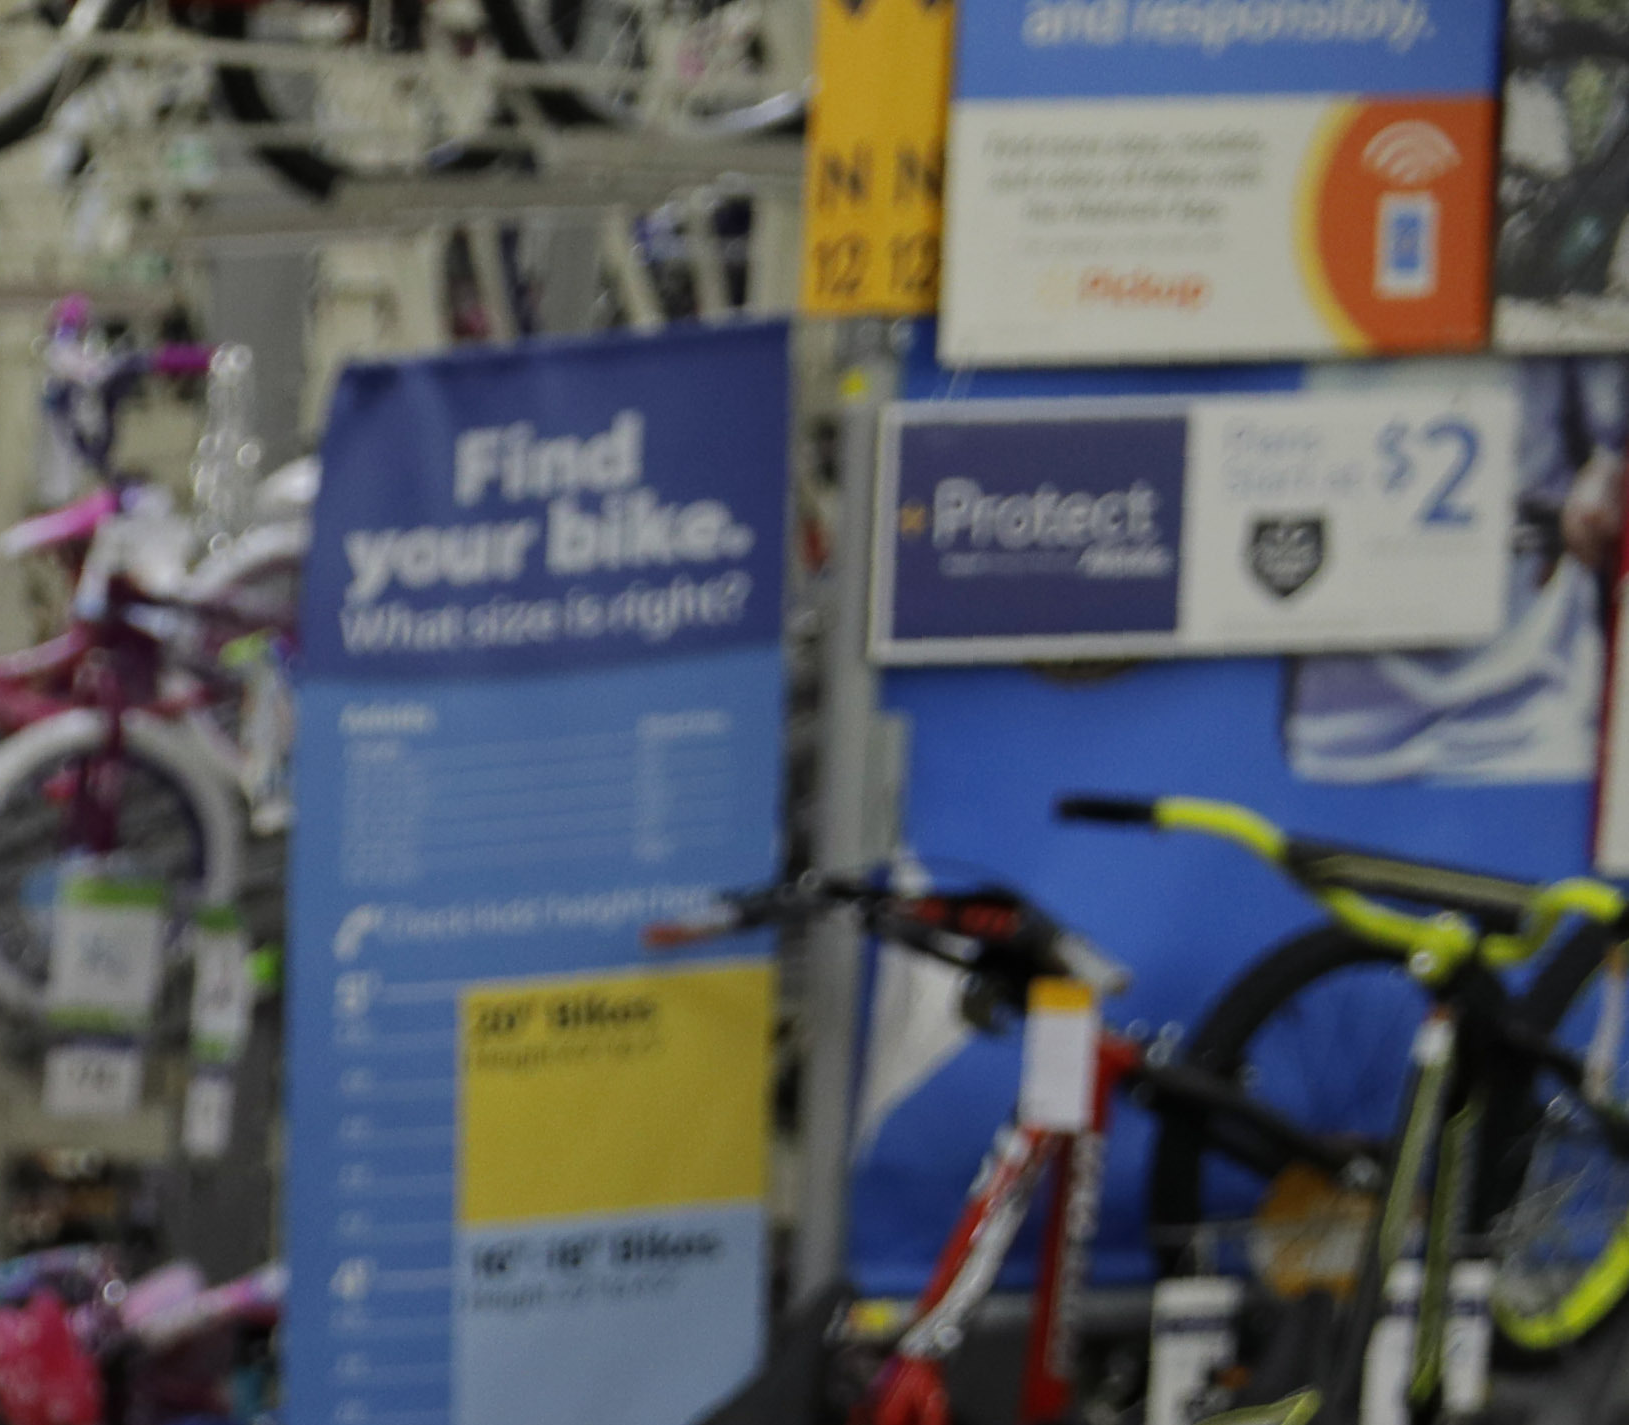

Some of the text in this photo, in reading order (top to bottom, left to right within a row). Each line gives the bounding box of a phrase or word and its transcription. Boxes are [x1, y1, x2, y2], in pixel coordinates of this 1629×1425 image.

[815, 234, 869, 300] 12
[452, 407, 646, 506] Find
[1373, 416, 1482, 532] $2
[344, 487, 757, 606] your bike.
[933, 476, 1160, 550] Protect
[339, 570, 754, 655] What size is right?
